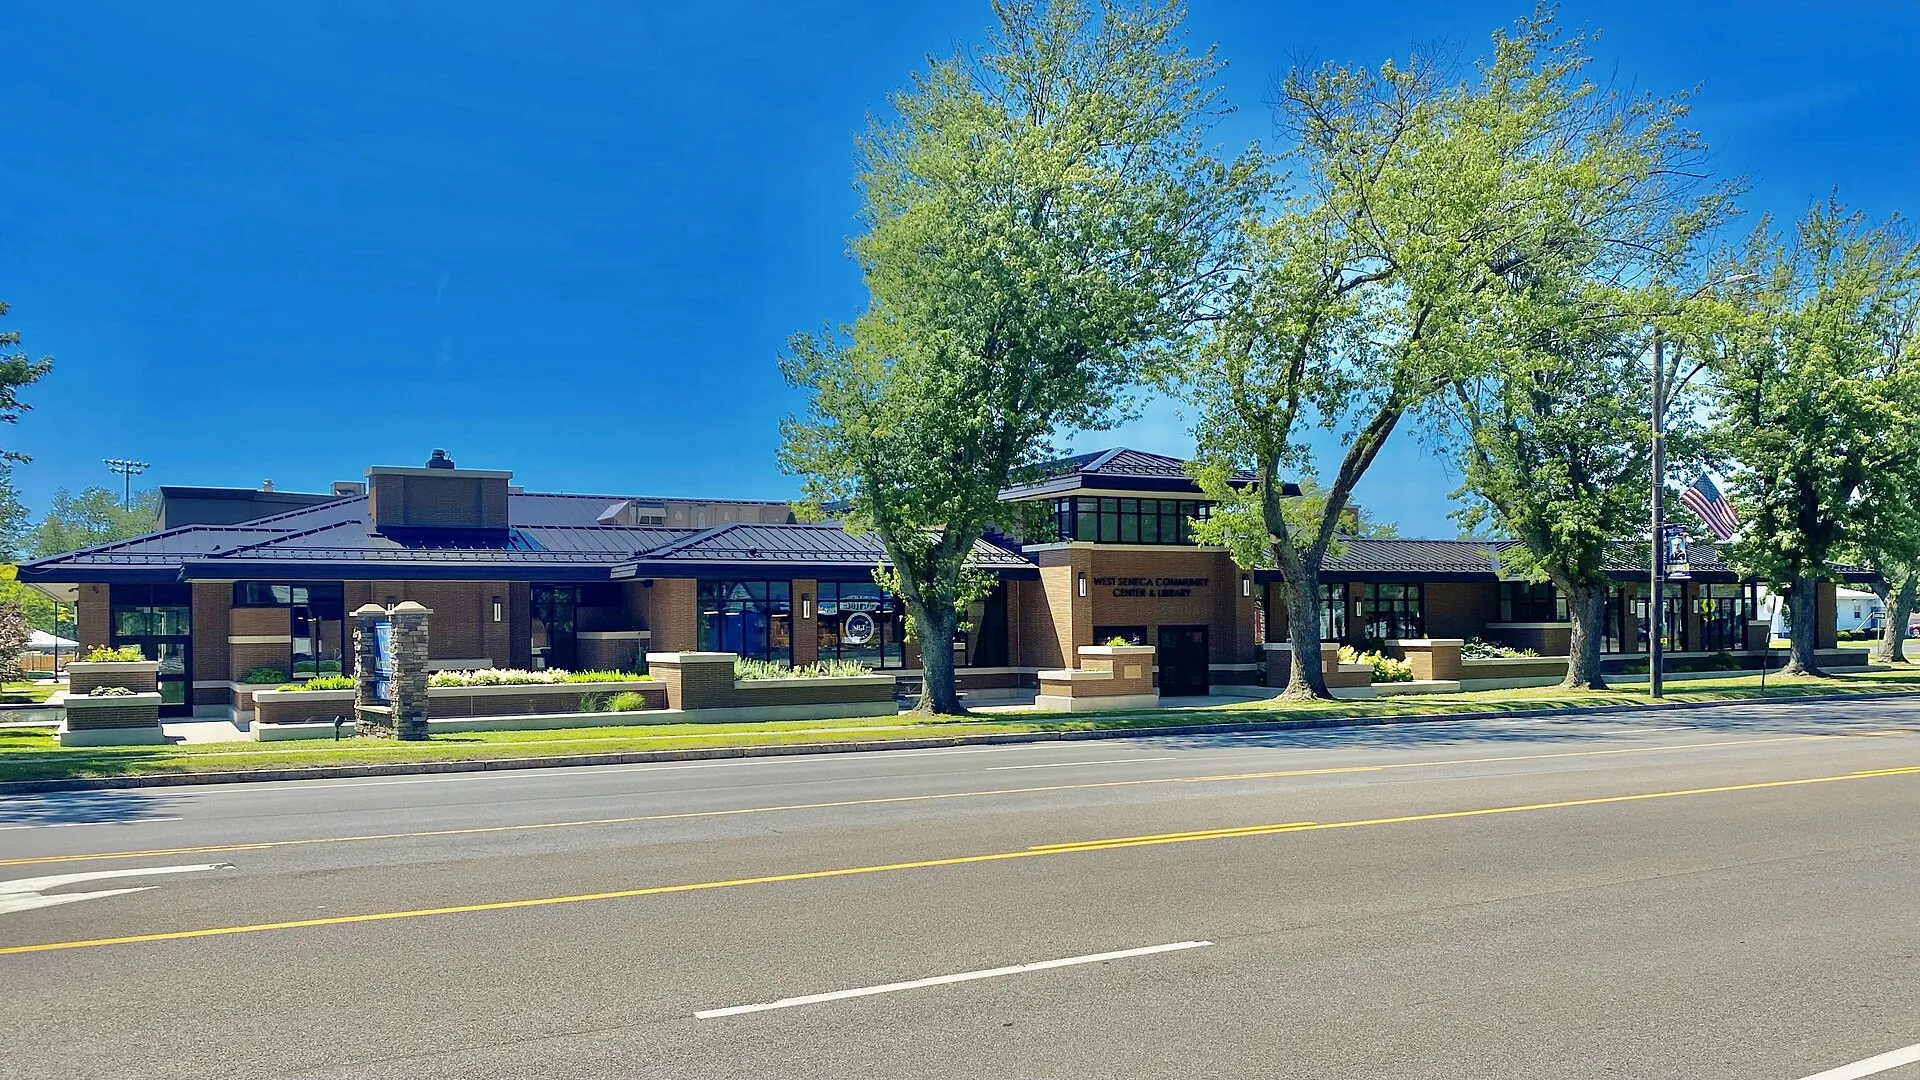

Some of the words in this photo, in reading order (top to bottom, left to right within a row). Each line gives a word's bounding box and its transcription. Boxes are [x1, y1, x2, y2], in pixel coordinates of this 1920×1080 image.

[1093, 577, 1116, 586] WEST
[1117, 577, 1153, 586] SENECA
[1155, 577, 1209, 587] COMMUNITY
[1113, 587, 1146, 597] CENTER
[1149, 588, 1156, 597] &
[1157, 587, 1192, 597] LIBRARY
